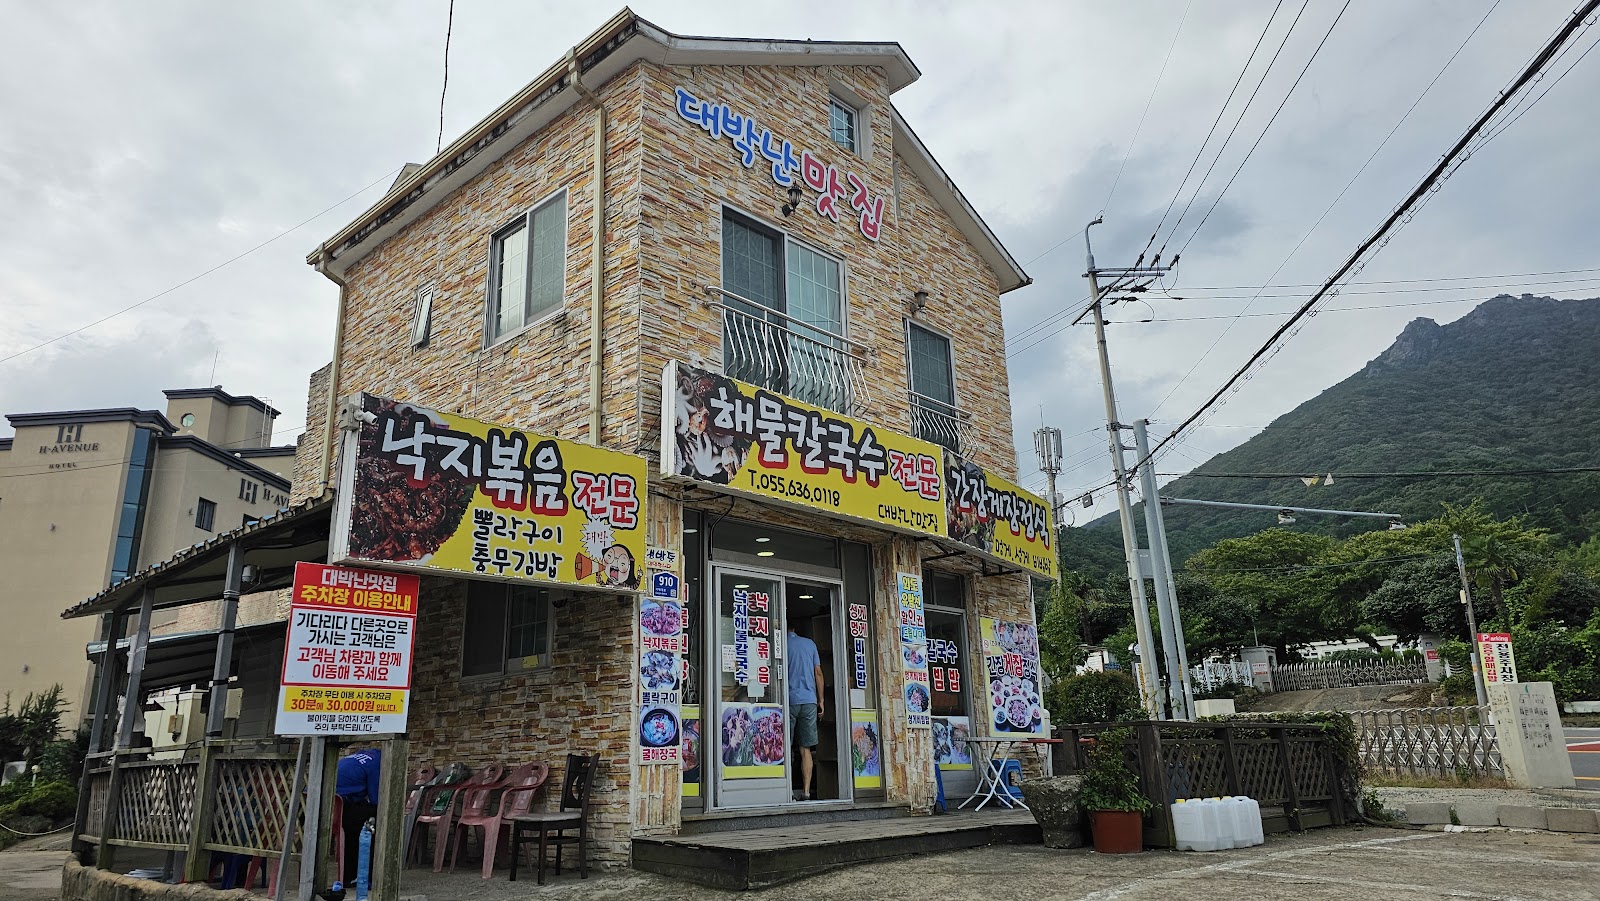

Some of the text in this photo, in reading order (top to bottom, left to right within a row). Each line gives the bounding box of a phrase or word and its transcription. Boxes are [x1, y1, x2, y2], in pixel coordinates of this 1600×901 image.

[675, 87, 884, 241] 대박난맛집
[709, 386, 940, 499] 해물칼국수 전문
[381, 417, 636, 525] 낙지볶음 전문
[747, 468, 841, 507] T.055.636.0118
[877, 504, 939, 533] 대박난맛집
[951, 469, 1050, 548] 간장게장정식
[473, 508, 563, 544] 뽈락구이
[585, 531, 609, 548] 대박
[471, 542, 563, 579] 충무김밥
[321, 568, 397, 593] 대박난맛집
[658, 575, 674, 587] 910
[301, 584, 411, 611] 주차장 이용안내
[297, 612, 408, 635] 기다리다 다른곳으로
[849, 604, 867, 620] 성게
[900, 609, 924, 628] 할인권
[308, 629, 396, 649] 가시는 고객님은
[734, 589, 748, 685] 낙지해물칼국수
[756, 592, 769, 685] 낙지볶음
[850, 621, 868, 637] 멍게
[642, 637, 678, 650] 낙지볶음
[297, 647, 401, 667] 고객님 차량과 함께
[854, 638, 867, 688] 비빔밥
[986, 652, 1039, 682] 간장게장정식
[1496, 643, 1514, 683] 전용주차장
[312, 663, 388, 681] 이동해 주세요
[290, 698, 397, 712] 30분에 30,000원 입니다.
[300, 689, 391, 700] 주차장 무단 이용 시 주차요금
[642, 691, 678, 704] 뽈락구이
[307, 714, 381, 724] 불이익을 당하지 않도록
[314, 723, 329, 732] 주의
[642, 748, 677, 761] 굴해장국
